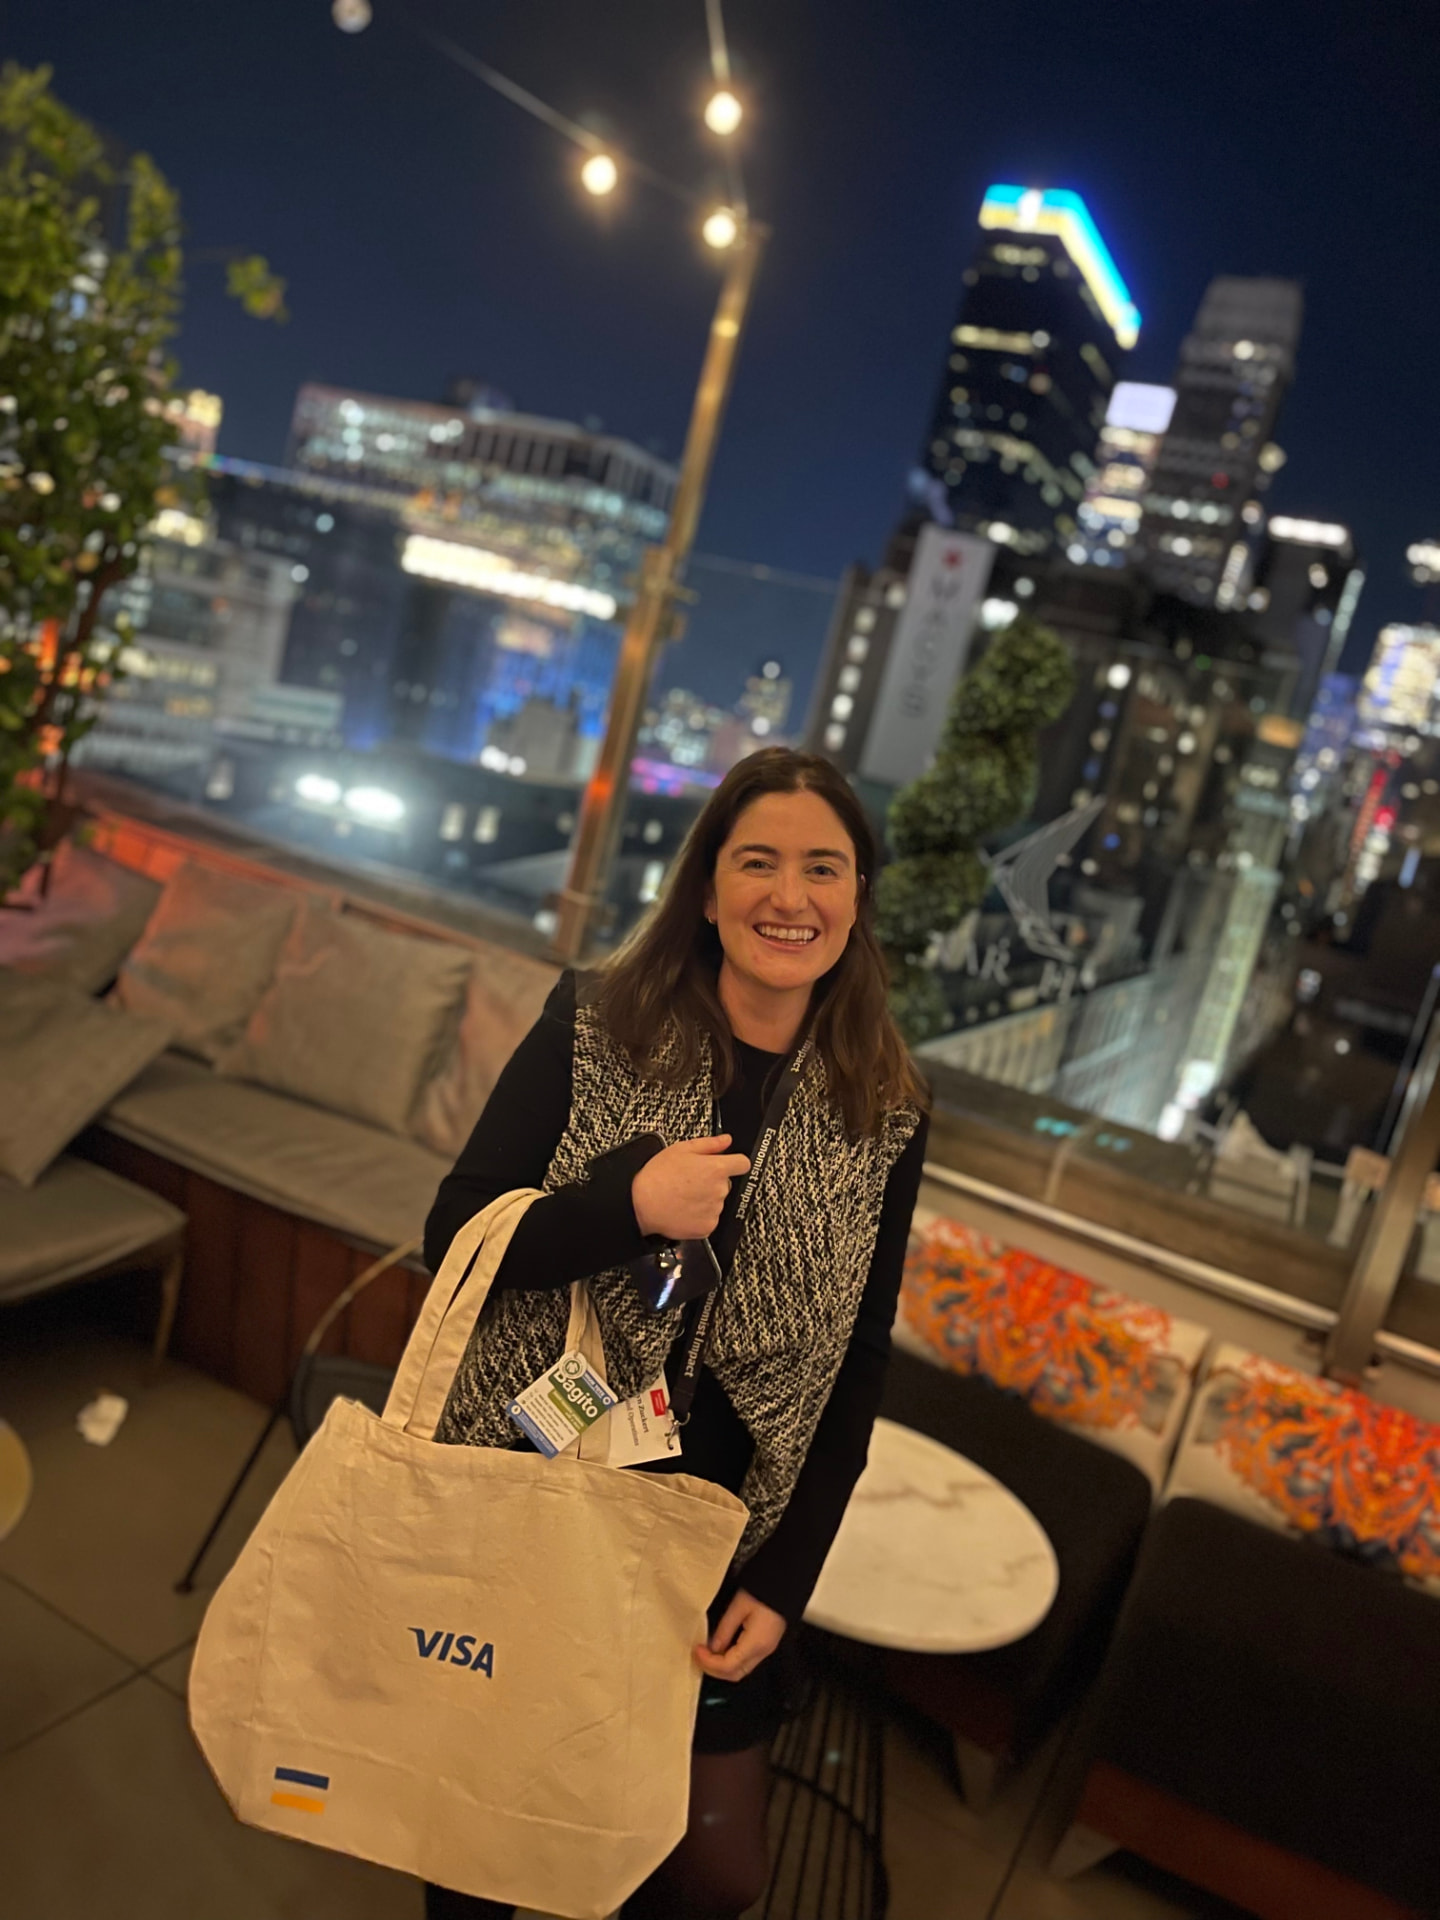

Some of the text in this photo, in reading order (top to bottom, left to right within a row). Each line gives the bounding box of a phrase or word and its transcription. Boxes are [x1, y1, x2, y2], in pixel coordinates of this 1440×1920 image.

[791, 1039, 813, 1073] Impact
[736, 1127, 776, 1220] Economist Impact
[684, 1287, 718, 1378] onomist Impact
[407, 1627, 494, 1680] VISA
